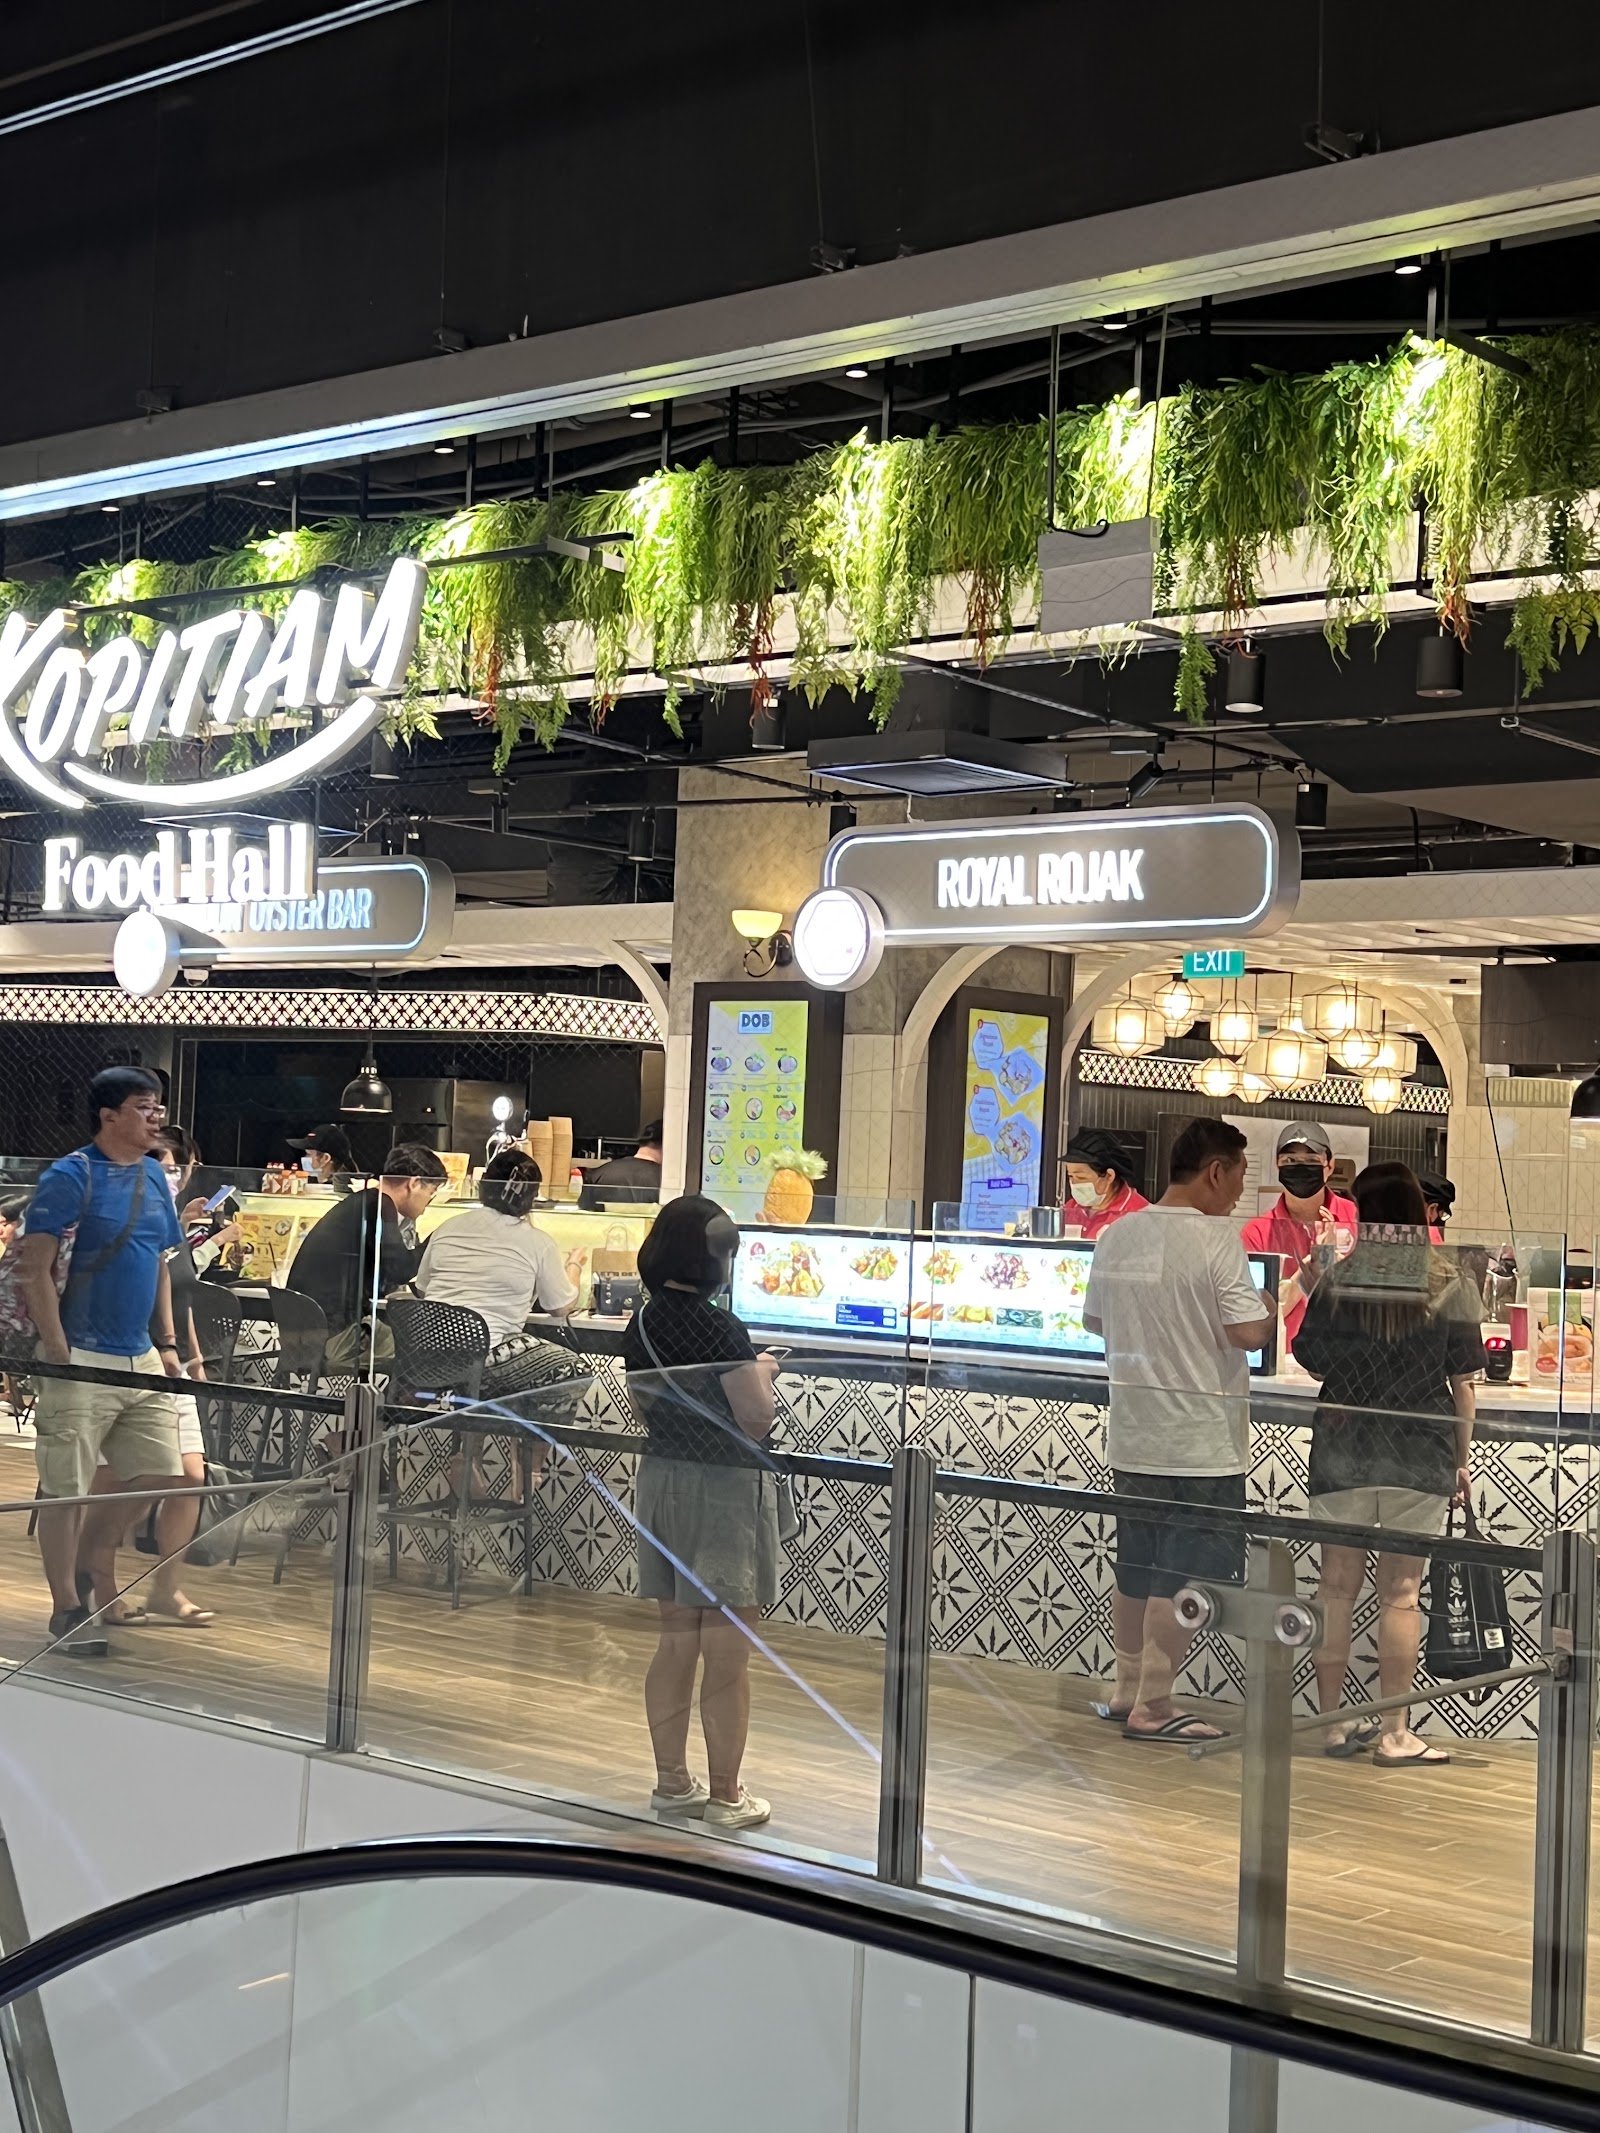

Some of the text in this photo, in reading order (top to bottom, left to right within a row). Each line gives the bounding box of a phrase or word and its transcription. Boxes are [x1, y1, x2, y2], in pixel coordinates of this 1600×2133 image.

[0, 557, 427, 790] KOPITIAM
[42, 823, 310, 911] Food Hall
[937, 848, 1145, 908] ROYAL ROJAK
[327, 887, 373, 930] BAR
[1193, 950, 1231, 972] EXIT
[741, 1013, 770, 1028] DOB
